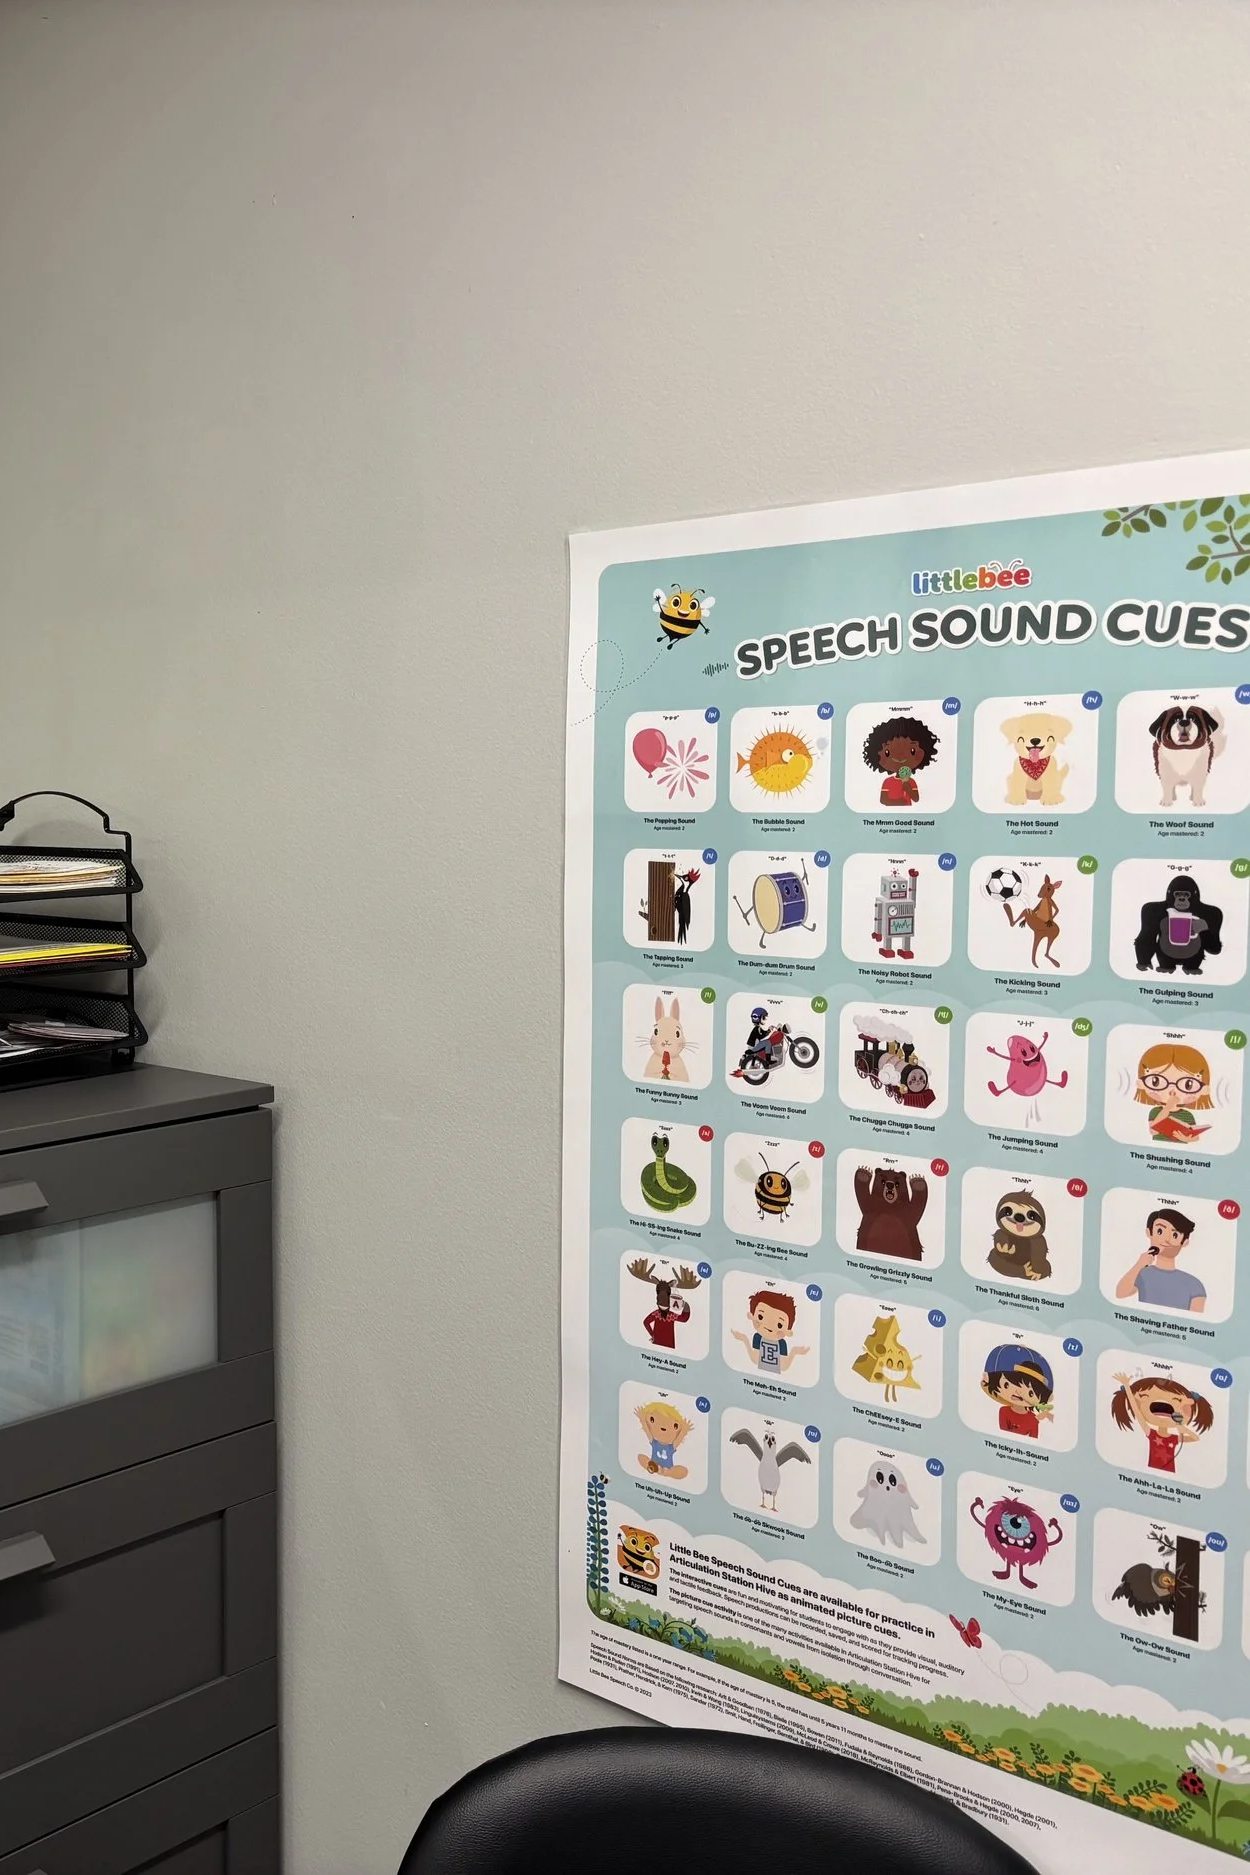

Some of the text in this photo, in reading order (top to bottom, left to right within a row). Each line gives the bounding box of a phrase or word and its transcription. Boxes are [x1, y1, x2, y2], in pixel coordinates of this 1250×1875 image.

[913, 566, 1031, 595] littlebee
[737, 603, 1250, 675] SPEECH SOUND CUES
[1081, 860, 1093, 869] /k/
[871, 969, 889, 977] Noisy
[889, 970, 909, 978] Robot
[910, 971, 932, 979] Sound
[1008, 978, 1036, 988] Kicking
[1036, 980, 1061, 988] Sound
[1154, 988, 1186, 998] Gulping
[1187, 990, 1213, 999] Sound
[849, 1114, 935, 1132] The Chugga Chugga Sound
[988, 1132, 1058, 1148] The Jumping Sound
[1129, 1151, 1211, 1168] The Shushing Sound
[1158, 1165, 1187, 1173] mastered:
[672, 1300, 679, 1309] A
[975, 1285, 1064, 1308] The Thankful Sloth Sound
[1114, 1312, 1215, 1337] The Shaving Father Sound
[761, 1342, 777, 1364] E
[1118, 1473, 1201, 1500] The Ahh-La-La Sound
[669, 1542, 935, 1638] Little Bee Speech Sound Cues are available for practice in
[669, 1554, 900, 1639] Articulation Station Hive as animated picture cues.
[982, 1590, 1046, 1615] The My-Eye Sound
[1119, 1632, 1190, 1659] The Ow-Ow Sound
